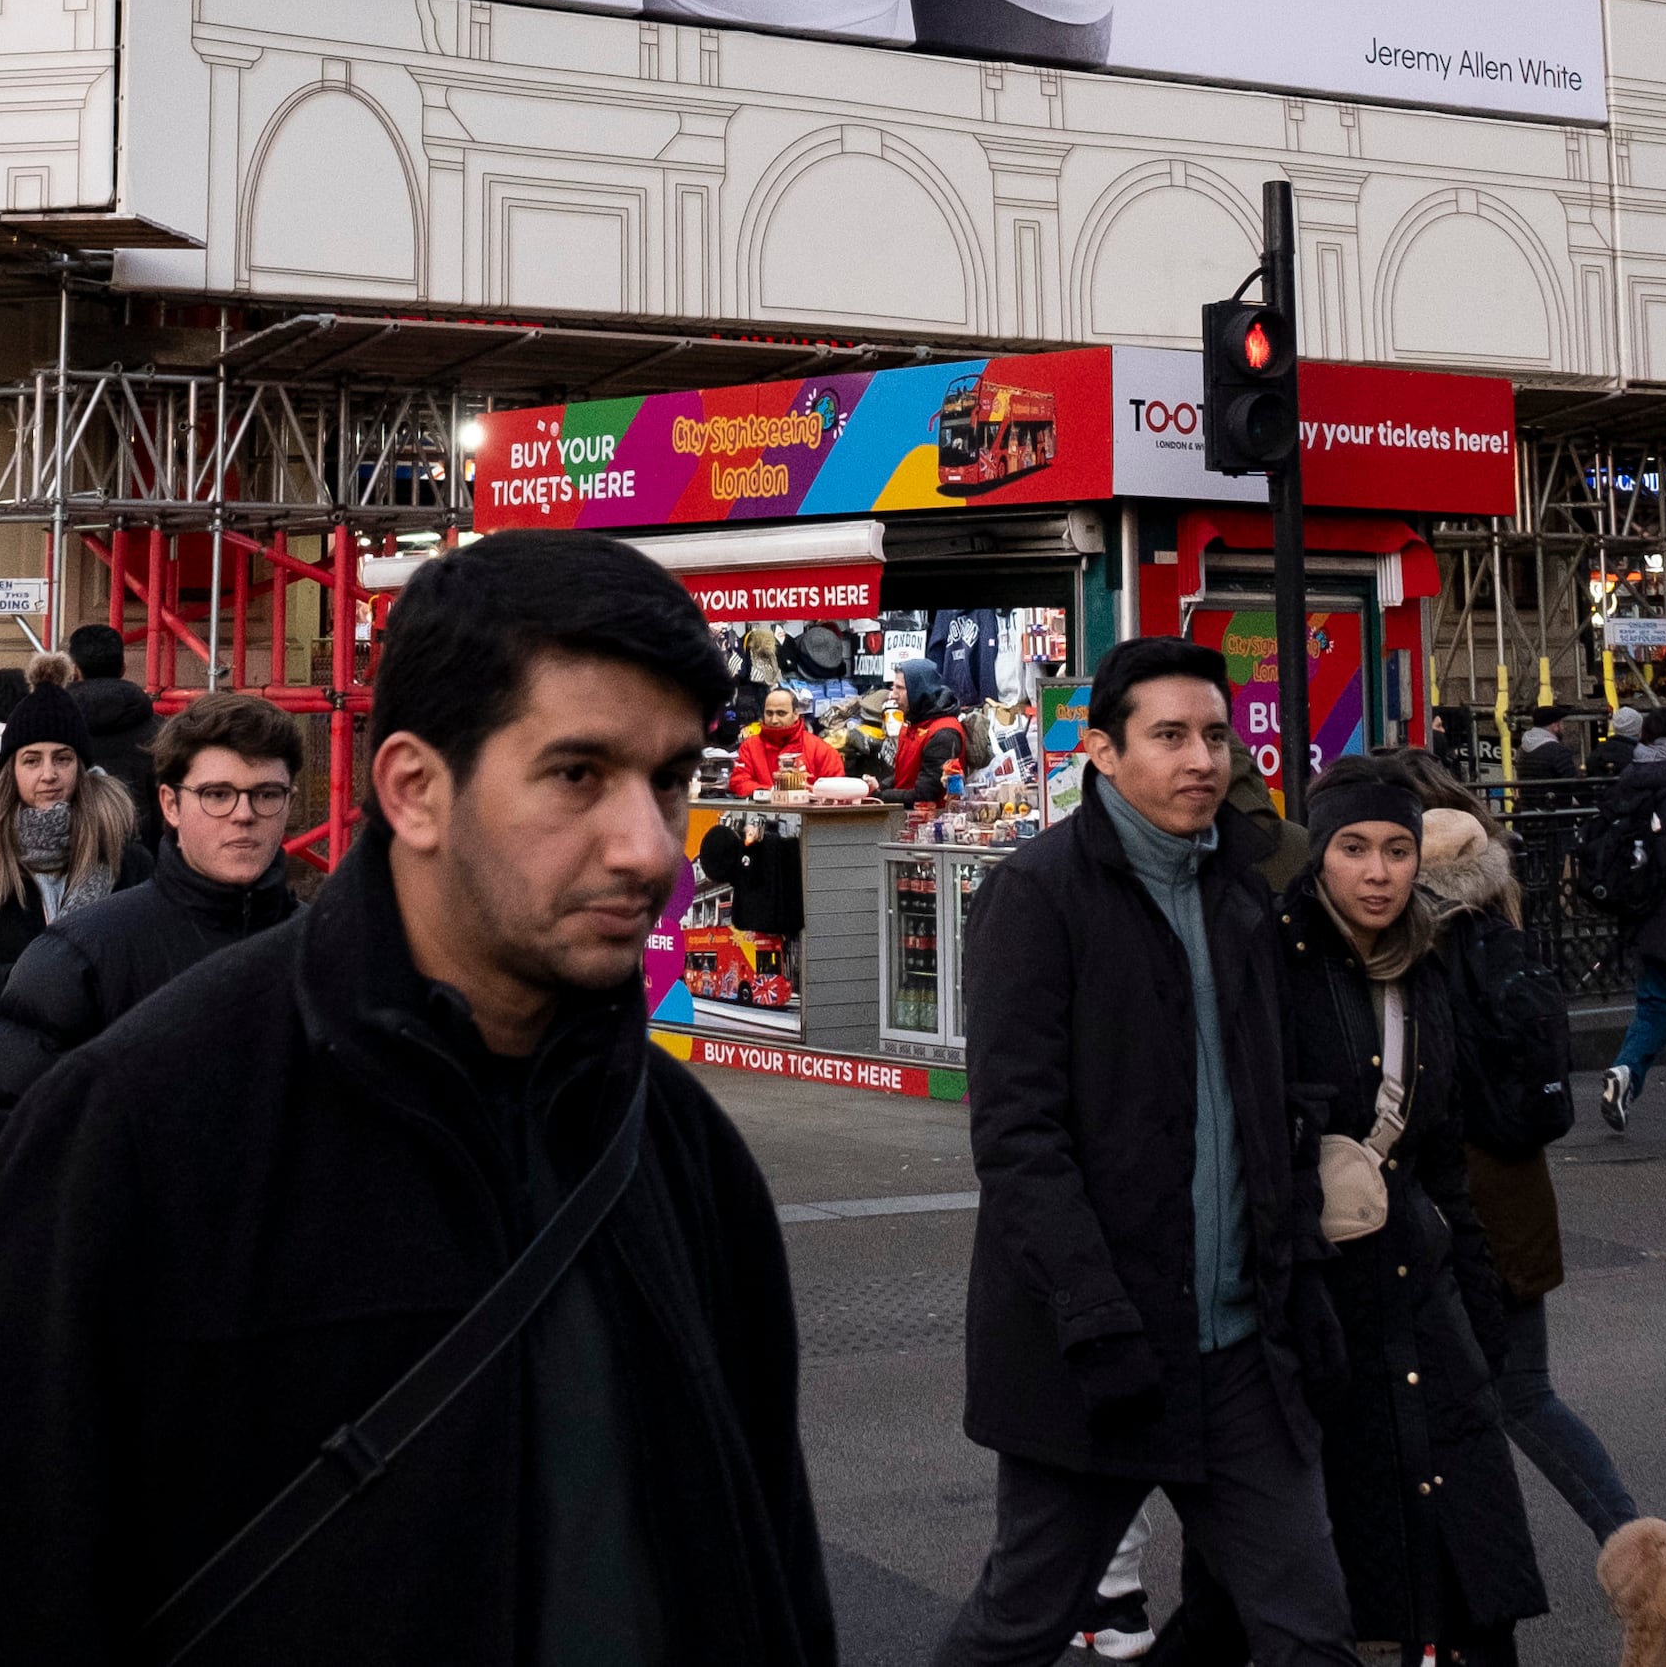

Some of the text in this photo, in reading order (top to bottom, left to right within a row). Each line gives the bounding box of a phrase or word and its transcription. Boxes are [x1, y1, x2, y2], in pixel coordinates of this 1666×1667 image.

[1365, 37, 1582, 91] Jeremy Allen White
[510, 435, 616, 469] BUY YOUR
[672, 415, 710, 457] City
[1155, 440, 1187, 451] LONDON
[1323, 422, 1375, 451] your
[1377, 421, 1451, 450] tickets
[1455, 426, 1510, 454] here!
[491, 469, 636, 507] TICKETS HERE
[711, 457, 789, 501] London
[700, 589, 749, 611] YOUR
[752, 586, 820, 609] TICKETS
[824, 584, 870, 606] HERE
[886, 633, 924, 651] LONDON
[704, 1042, 902, 1090] BUY YOUR TICKETS HERE
